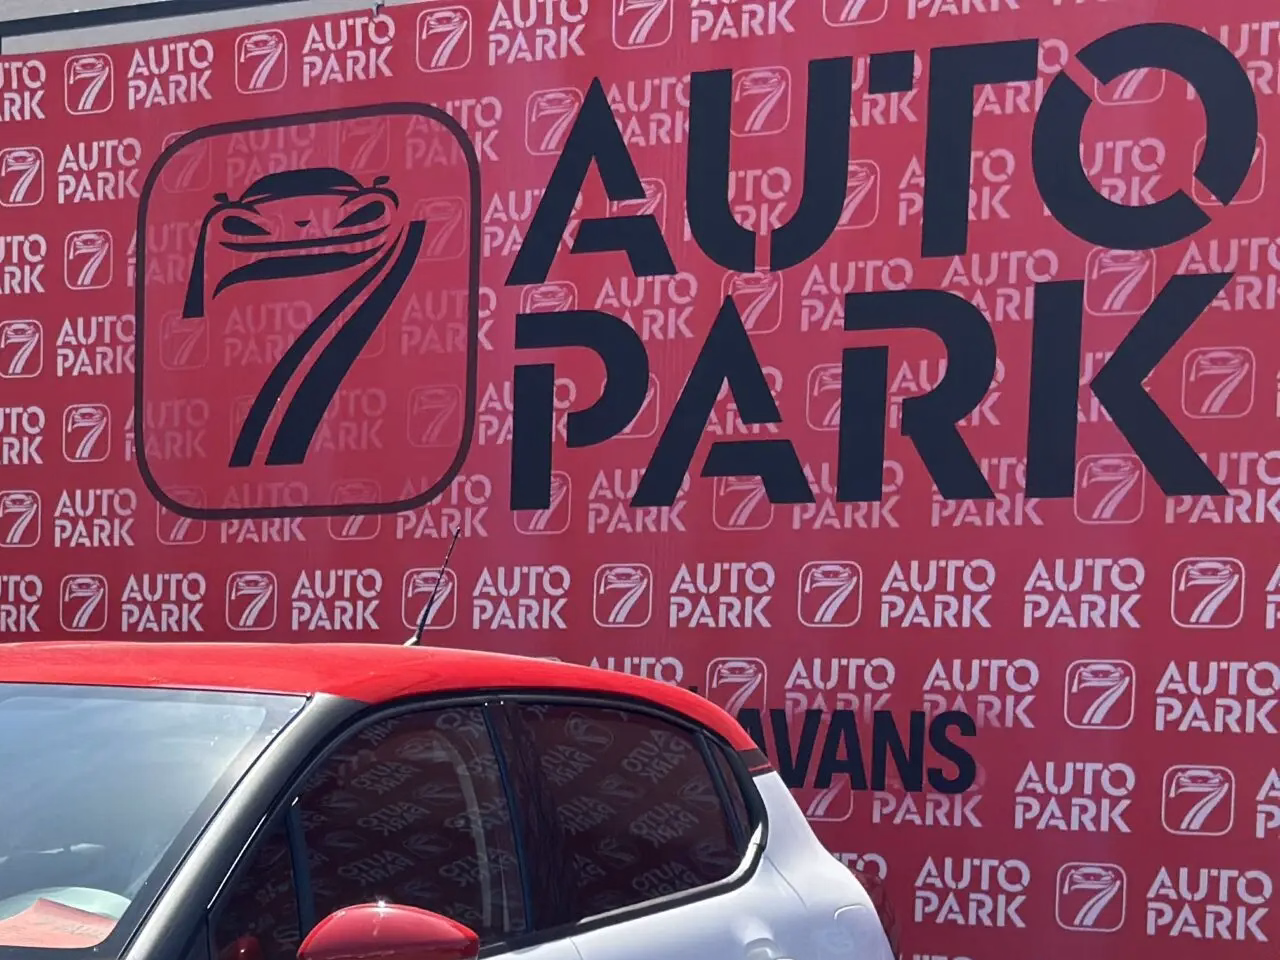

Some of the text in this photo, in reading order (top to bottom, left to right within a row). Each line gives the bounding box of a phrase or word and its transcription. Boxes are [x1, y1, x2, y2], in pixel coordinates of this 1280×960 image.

[488, 0, 588, 31] AUTO
[691, 0, 796, 43] PARK
[303, 14, 396, 54] AUTO
[489, 24, 586, 66] PARK
[128, 38, 213, 78] AUTO
[303, 46, 393, 87] PARK
[128, 70, 212, 110] PARK
[57, 138, 141, 173] AUTO
[505, 22, 1259, 286] AUTO
[58, 169, 139, 204] PARK
[801, 257, 914, 297] AUTO
[941, 248, 1059, 289] AUTO
[595, 272, 699, 310] AUTO
[56, 315, 137, 346] AUTO
[57, 345, 137, 377] PARK
[510, 272, 1236, 510] PARK
[54, 488, 136, 517] AUTO
[588, 500, 687, 534] PARK
[792, 497, 900, 529] PARK
[931, 496, 1044, 527] PARK
[55, 518, 134, 547] PARK
[220, 517, 307, 543] PARK
[396, 507, 489, 540] PARK
[121, 573, 206, 601] AUTO
[292, 568, 382, 599] AUTO
[473, 565, 570, 596] AUTO
[670, 562, 775, 594] AUTO
[881, 559, 995, 592] AUTO
[1024, 558, 1145, 592] AUTO
[122, 603, 203, 631] PARK
[292, 600, 379, 630] PARK
[473, 598, 567, 629] PARK
[670, 596, 772, 627] PARK
[881, 595, 992, 627] PARK
[1024, 594, 1141, 628] PARK
[785, 657, 896, 691] AUTO
[923, 658, 1039, 692] AUTO
[1155, 661, 1280, 696] AUTO
[1156, 697, 1278, 733] PARK
[1015, 761, 1135, 796] AUTO
[873, 794, 983, 827] PARK
[1015, 796, 1131, 832] PARK
[915, 856, 1030, 892] AUTO
[1146, 866, 1272, 904] AUTO
[915, 890, 1026, 928] PARK
[1147, 902, 1269, 942] PARK
